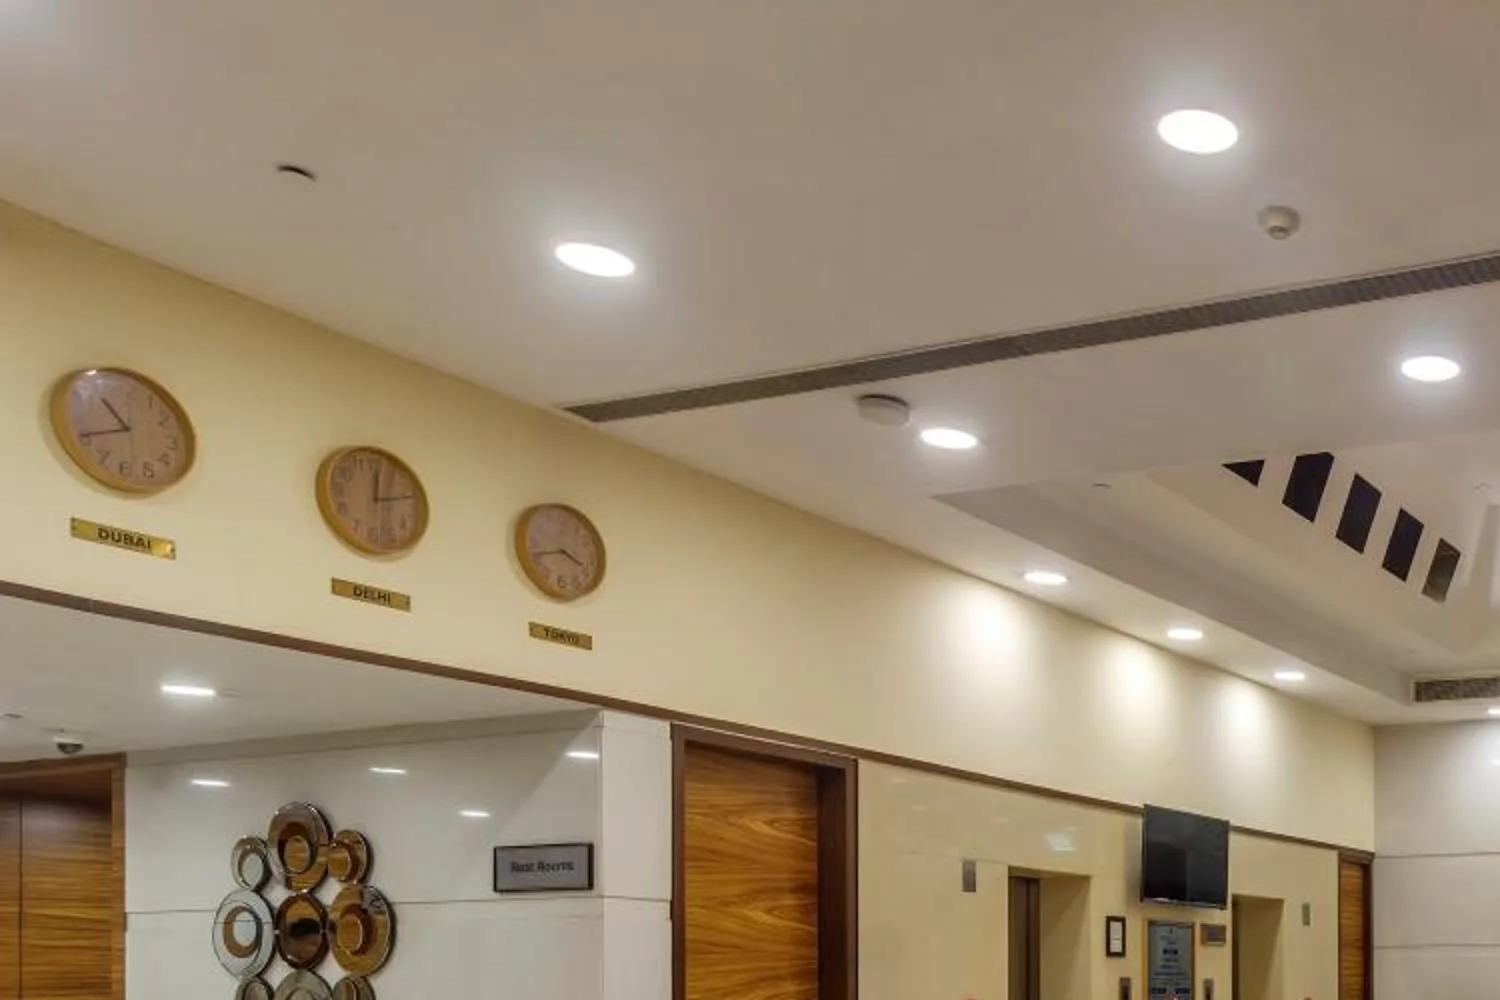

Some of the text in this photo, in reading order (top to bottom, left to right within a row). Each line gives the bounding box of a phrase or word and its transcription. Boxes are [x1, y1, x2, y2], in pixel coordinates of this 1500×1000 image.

[117, 460, 132, 477] 6
[142, 460, 155, 479] 5
[97, 526, 151, 549] DUBAI
[353, 585, 391, 604] DELHI
